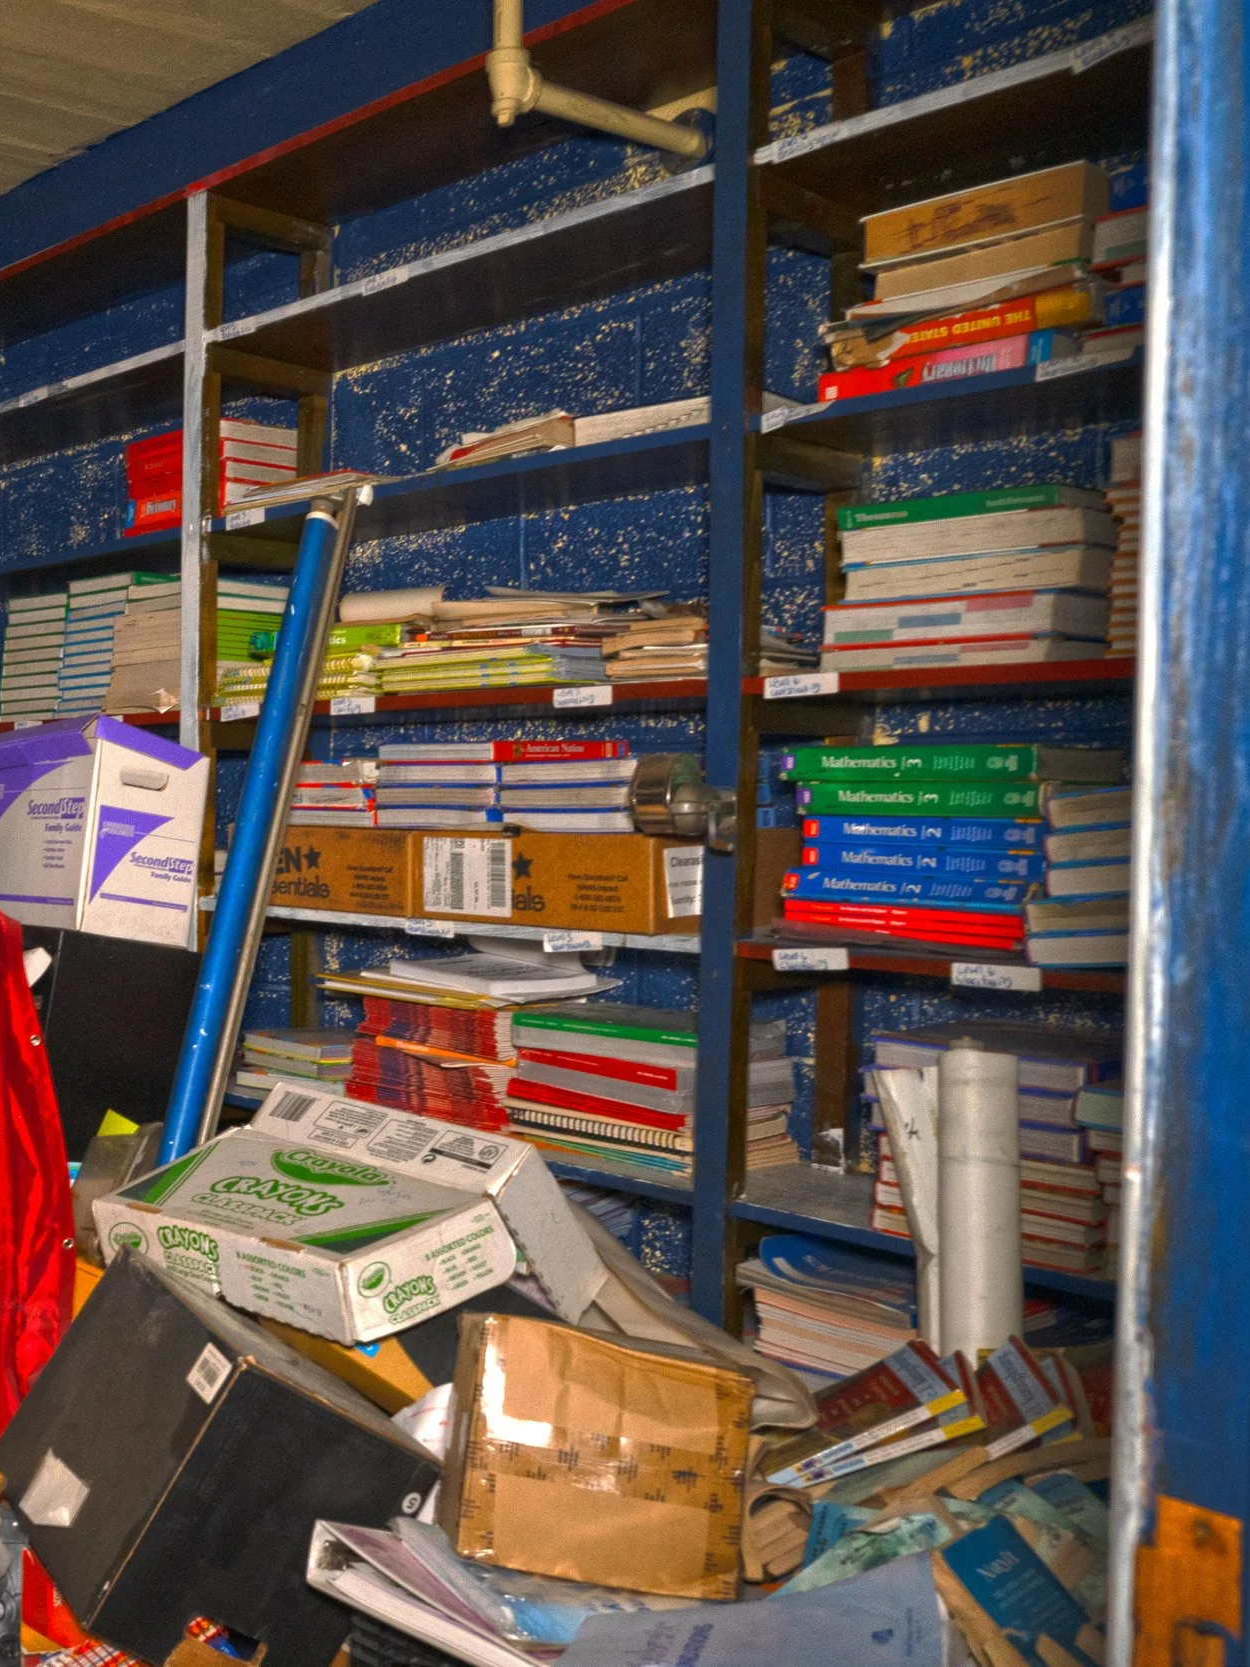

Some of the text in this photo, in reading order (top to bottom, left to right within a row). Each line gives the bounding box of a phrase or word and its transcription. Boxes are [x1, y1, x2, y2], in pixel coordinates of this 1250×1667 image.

[909, 325, 949, 342] STATE
[1004, 309, 1032, 323] THE
[822, 755, 897, 769] Mathematics
[838, 790, 914, 803] Mathematics
[44, 823, 83, 835] Family Guide
[843, 822, 917, 838] Mathematics
[841, 851, 913, 867] Mathematics
[150, 872, 192, 884] Family Guide
[823, 877, 897, 893] Mathematics
[282, 1148, 387, 1186] Crayola
[191, 1192, 303, 1227] CLASSPACK
[209, 1176, 345, 1217] CRAYONS
[157, 1224, 220, 1263] CRAYONS
[430, 1238, 467, 1260] ASSORTED
[466, 1225, 495, 1245] COLORS
[241, 1252, 278, 1270] ASSORTED
[278, 1262, 307, 1280] COLORS
[382, 1275, 437, 1314] CRAYONS
